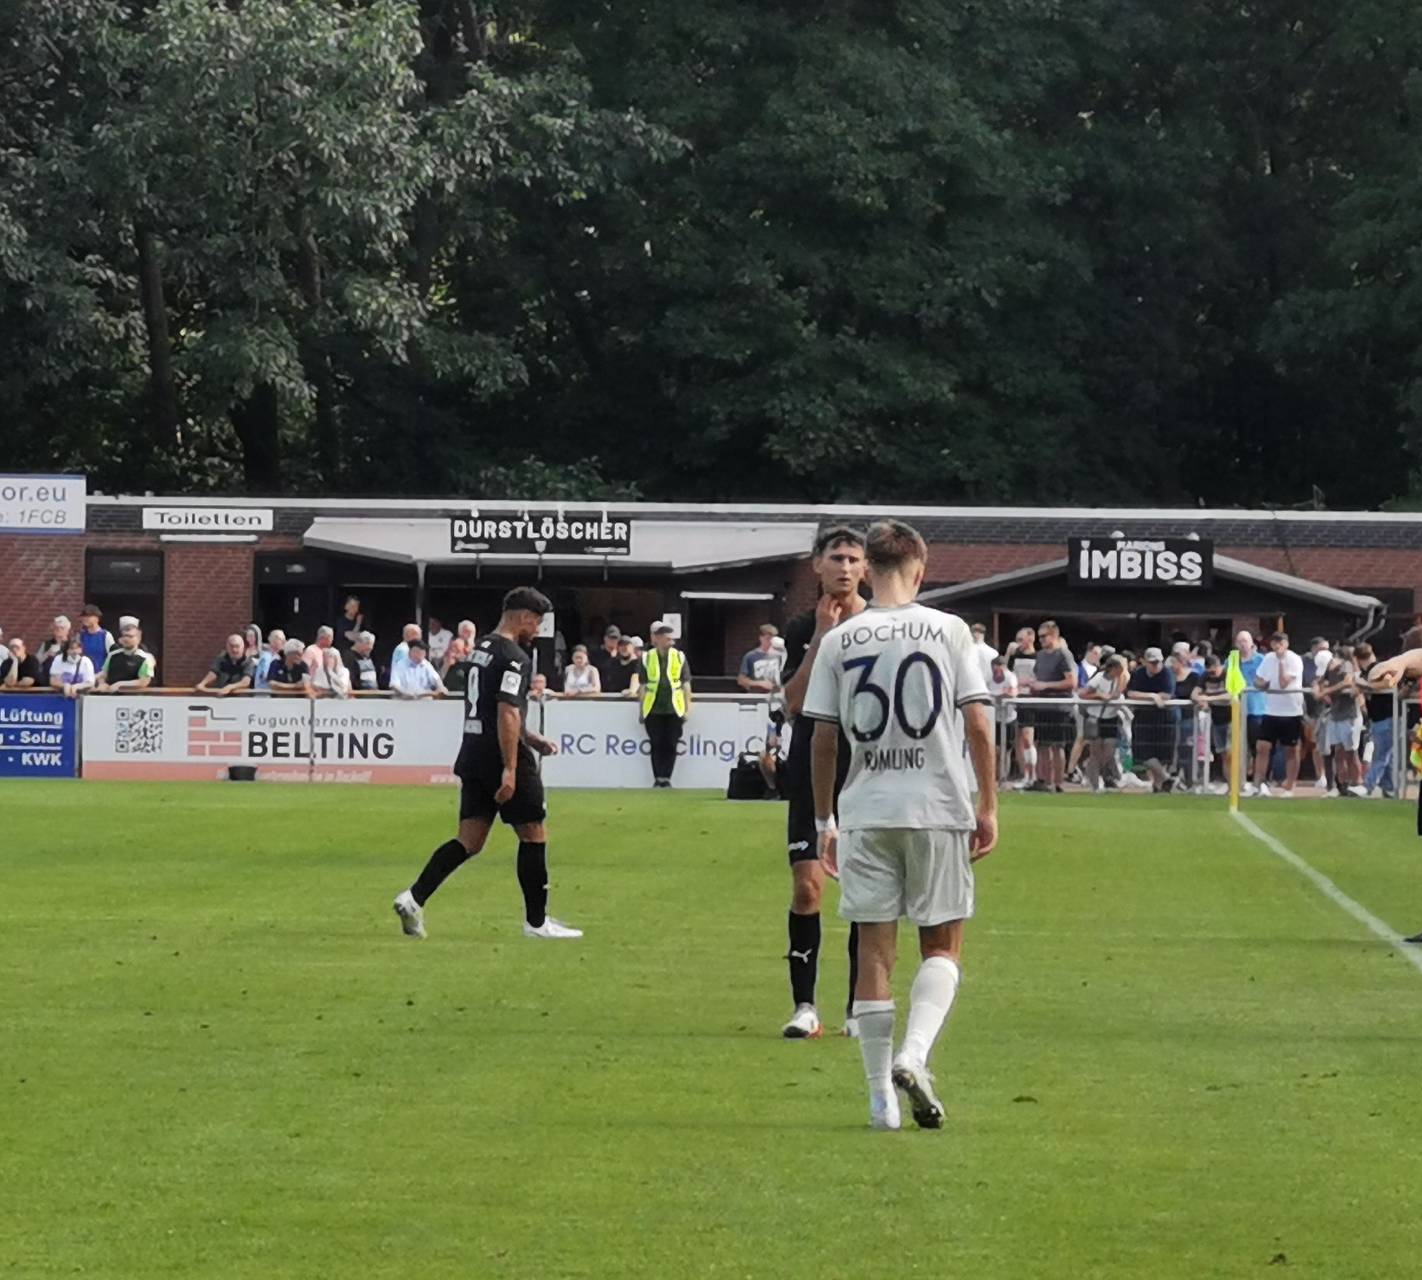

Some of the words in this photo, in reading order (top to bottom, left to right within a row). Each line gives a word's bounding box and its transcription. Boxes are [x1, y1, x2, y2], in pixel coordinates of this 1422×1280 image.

[20, 509, 67, 525] 1FCB
[155, 512, 262, 526] Toiletten
[1080, 550, 1203, 580] IMBISS
[841, 622, 945, 650] BOCHUM
[842, 651, 943, 743] 30
[0, 708, 64, 725] Lüftung
[20, 730, 64, 744] Solar
[248, 731, 395, 760] BELTING
[606, 734, 736, 762] Reccling
[21, 752, 63, 766] KWK
